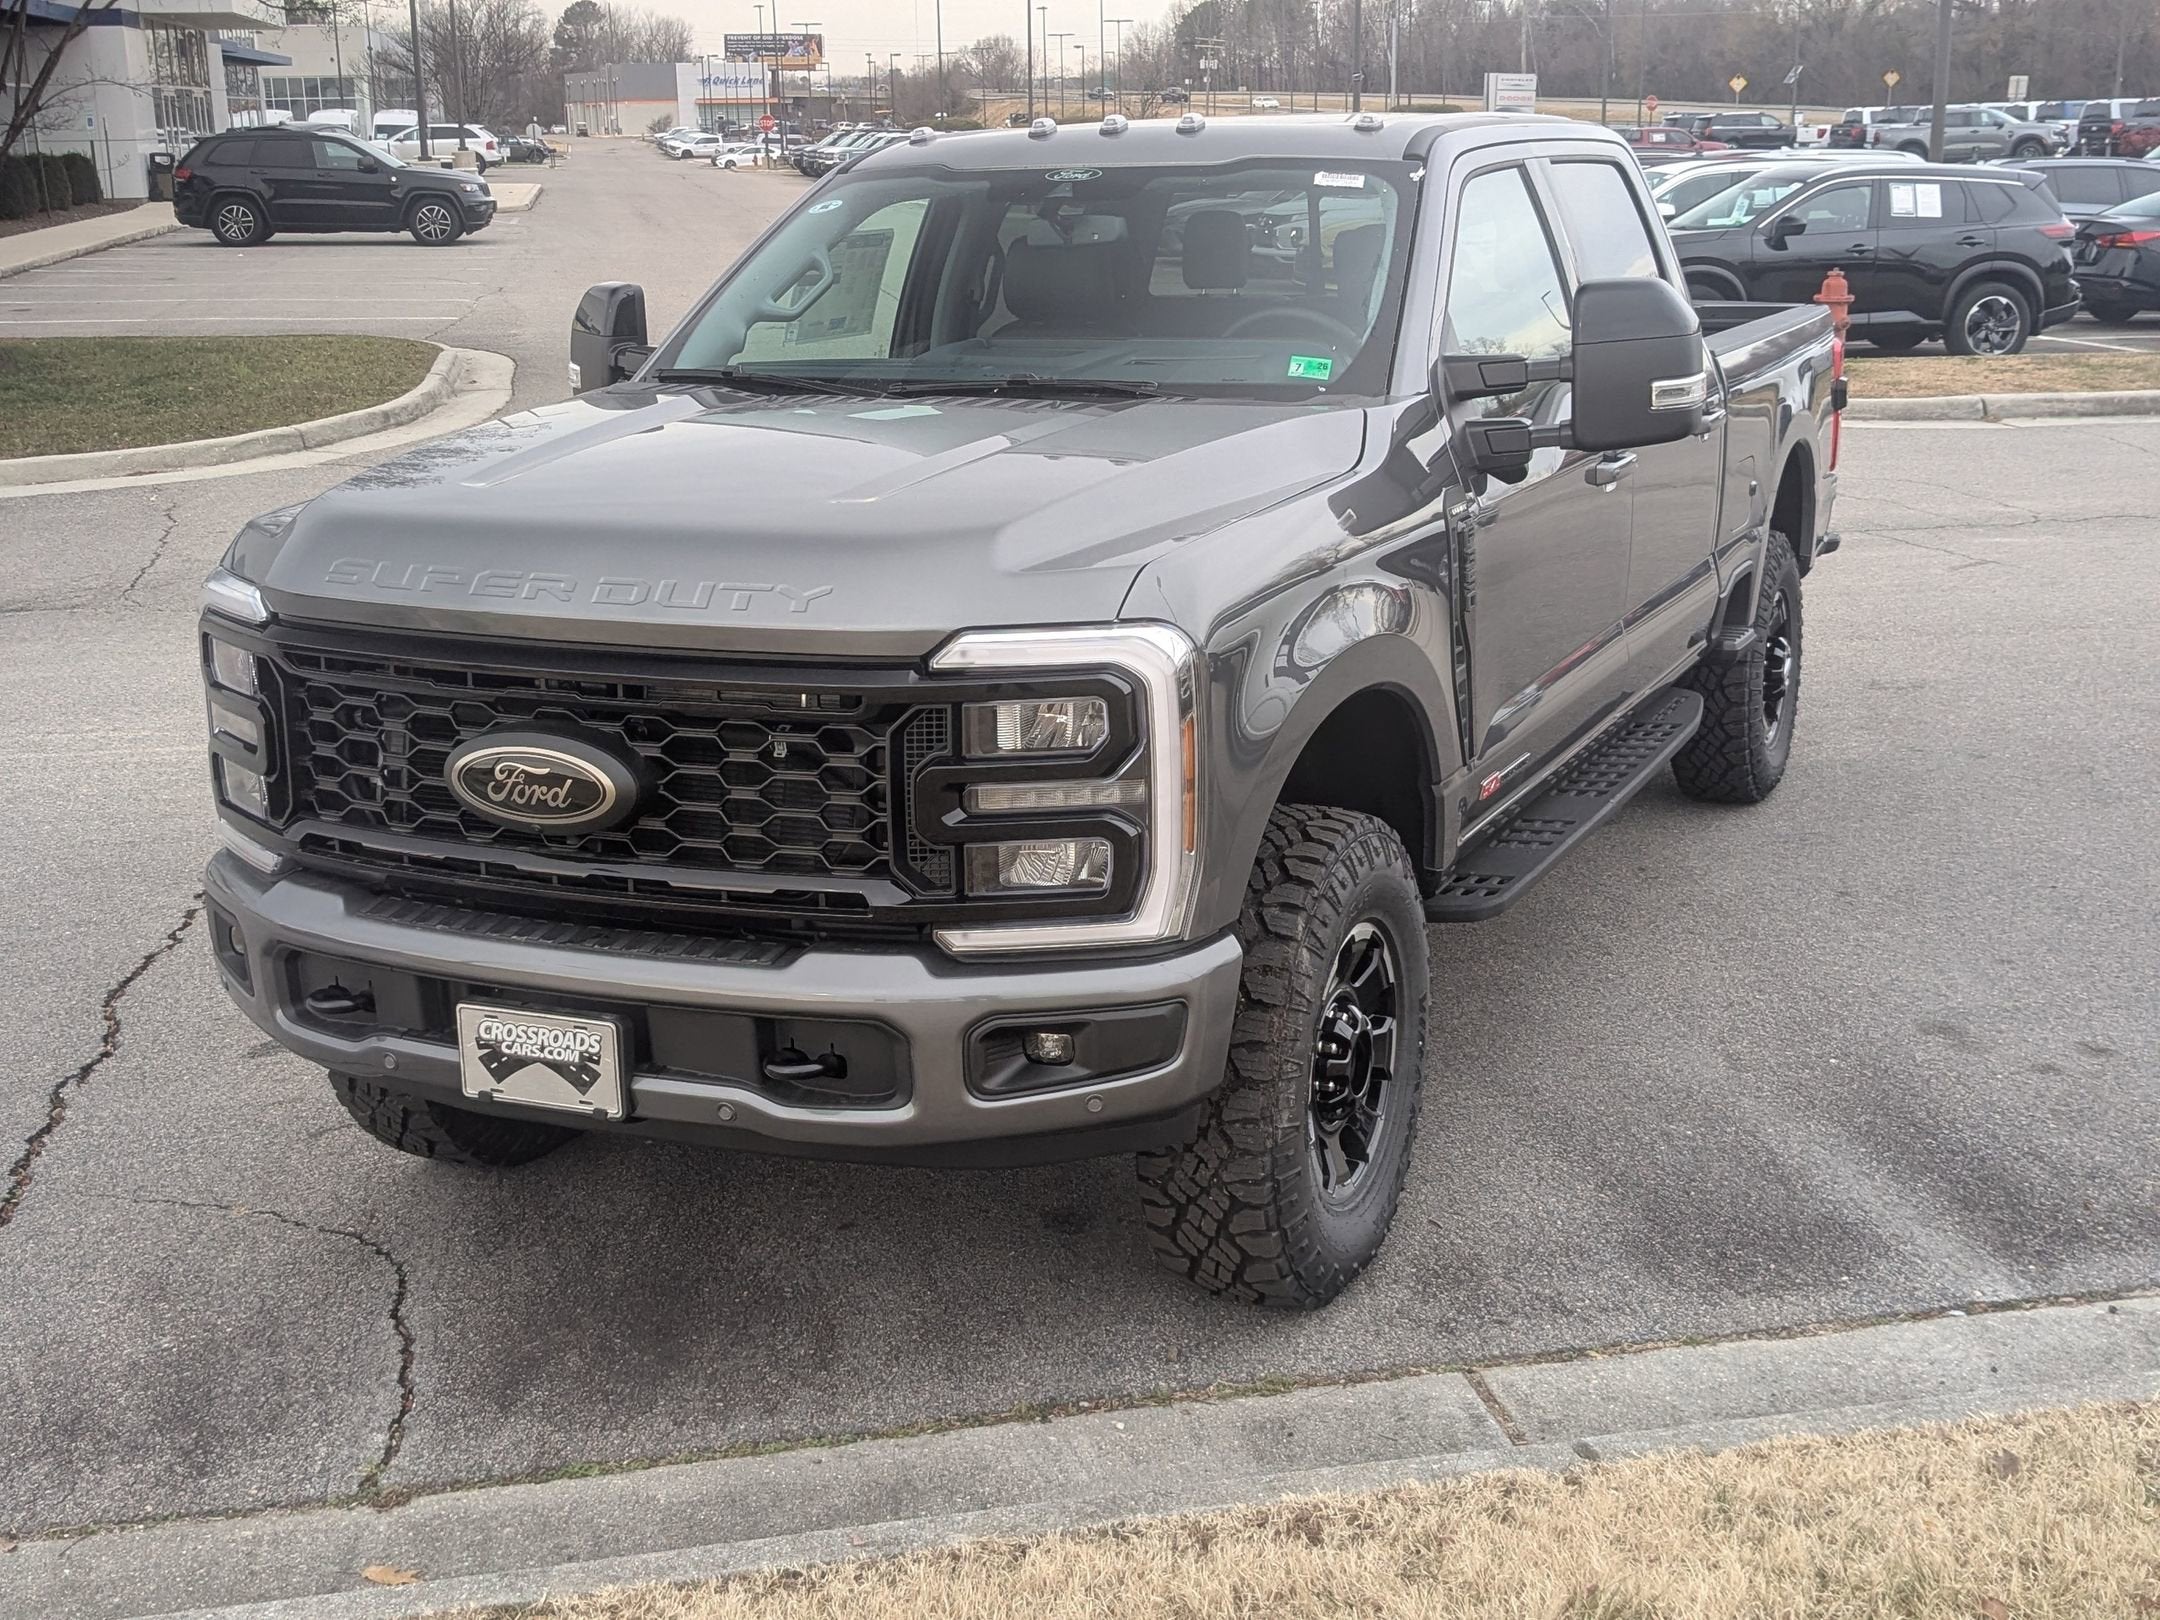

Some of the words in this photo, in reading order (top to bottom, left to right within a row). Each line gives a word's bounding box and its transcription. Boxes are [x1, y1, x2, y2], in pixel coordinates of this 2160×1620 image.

[712, 75, 740, 86] Quick
[1295, 362, 1302, 372] 7
[1316, 362, 1328, 371] 26
[325, 556, 578, 602] SUPER
[591, 575, 834, 613] DUTY
[488, 762, 573, 808] Ford
[477, 1019, 602, 1054] CROSSROADS
[501, 1041, 580, 1063] CARS.COM
